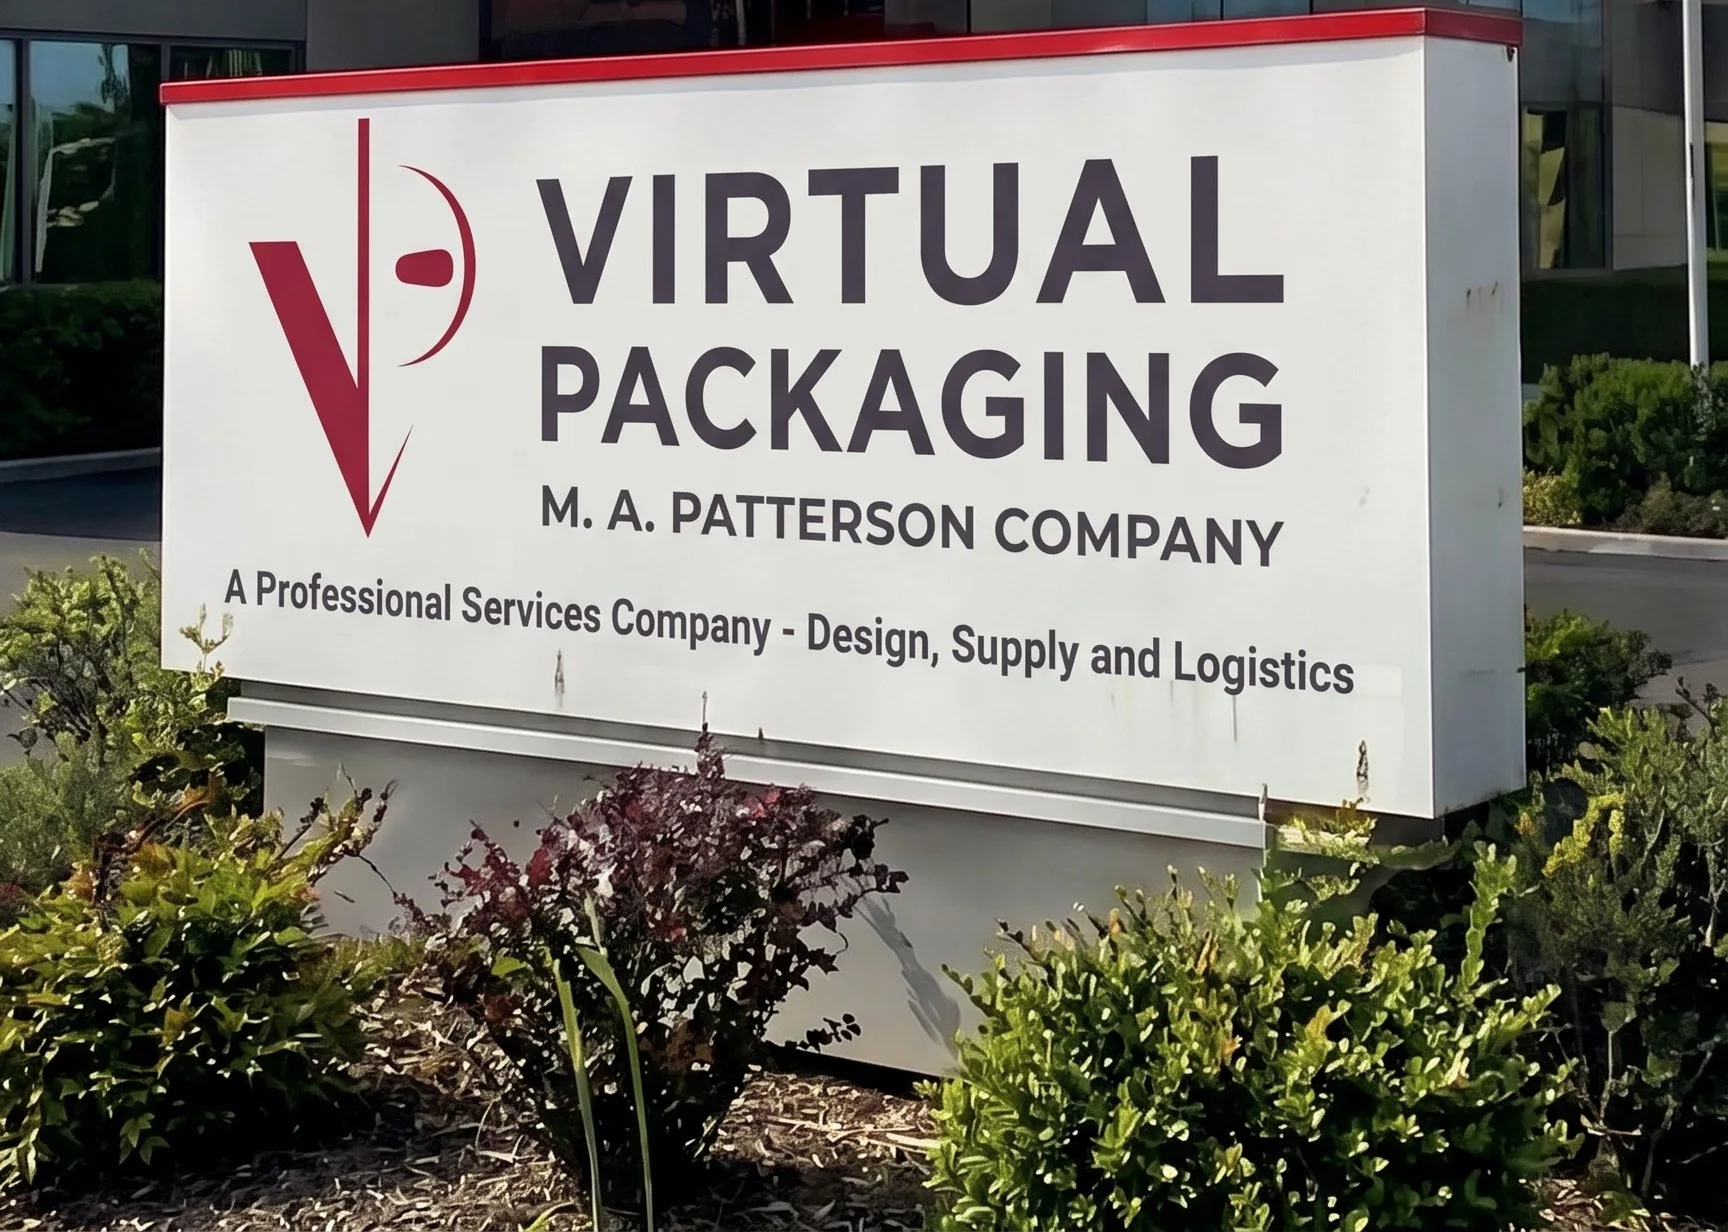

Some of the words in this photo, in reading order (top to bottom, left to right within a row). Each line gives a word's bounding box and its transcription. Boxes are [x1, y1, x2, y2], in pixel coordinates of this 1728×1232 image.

[536, 156, 1284, 305] VIRTUAL
[541, 346, 1282, 470] PACKAGING
[542, 484, 593, 530] M.
[607, 489, 655, 533] A.
[672, 491, 974, 550] PATTERSON
[995, 507, 1285, 567] COMPANY
[225, 568, 247, 605] A
[256, 570, 451, 621] Professional
[461, 586, 601, 634] Services
[611, 597, 771, 657] Company
[782, 628, 795, 636] -
[808, 612, 939, 669] Design,
[951, 624, 1080, 682] Supply
[1090, 636, 1160, 679] and
[1174, 640, 1355, 696] Logistics
